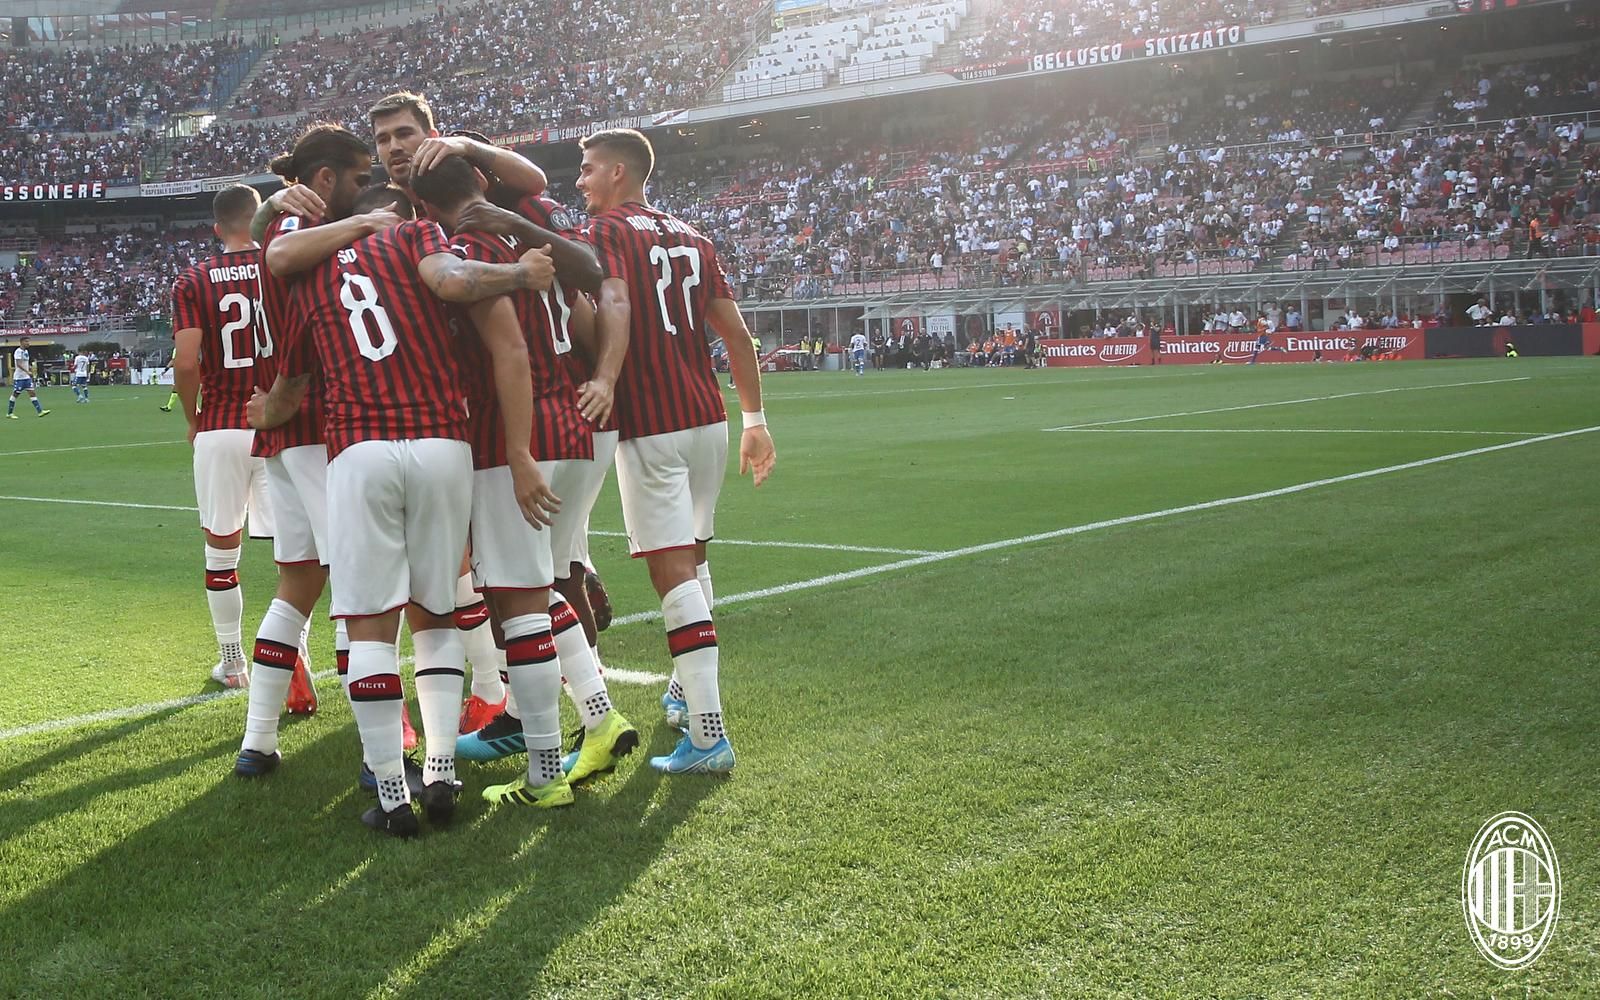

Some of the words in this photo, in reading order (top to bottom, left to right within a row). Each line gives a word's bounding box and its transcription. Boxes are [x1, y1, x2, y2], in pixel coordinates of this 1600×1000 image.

[1034, 43, 1122, 71] BELLUSCO
[1145, 25, 1240, 57] SKIZZATO
[340, 272, 398, 361] 8
[1103, 344, 1114, 355] FLY
[1115, 343, 1138, 355] BETTER
[1228, 341, 1240, 352] FLY
[1287, 337, 1356, 351] Emirates
